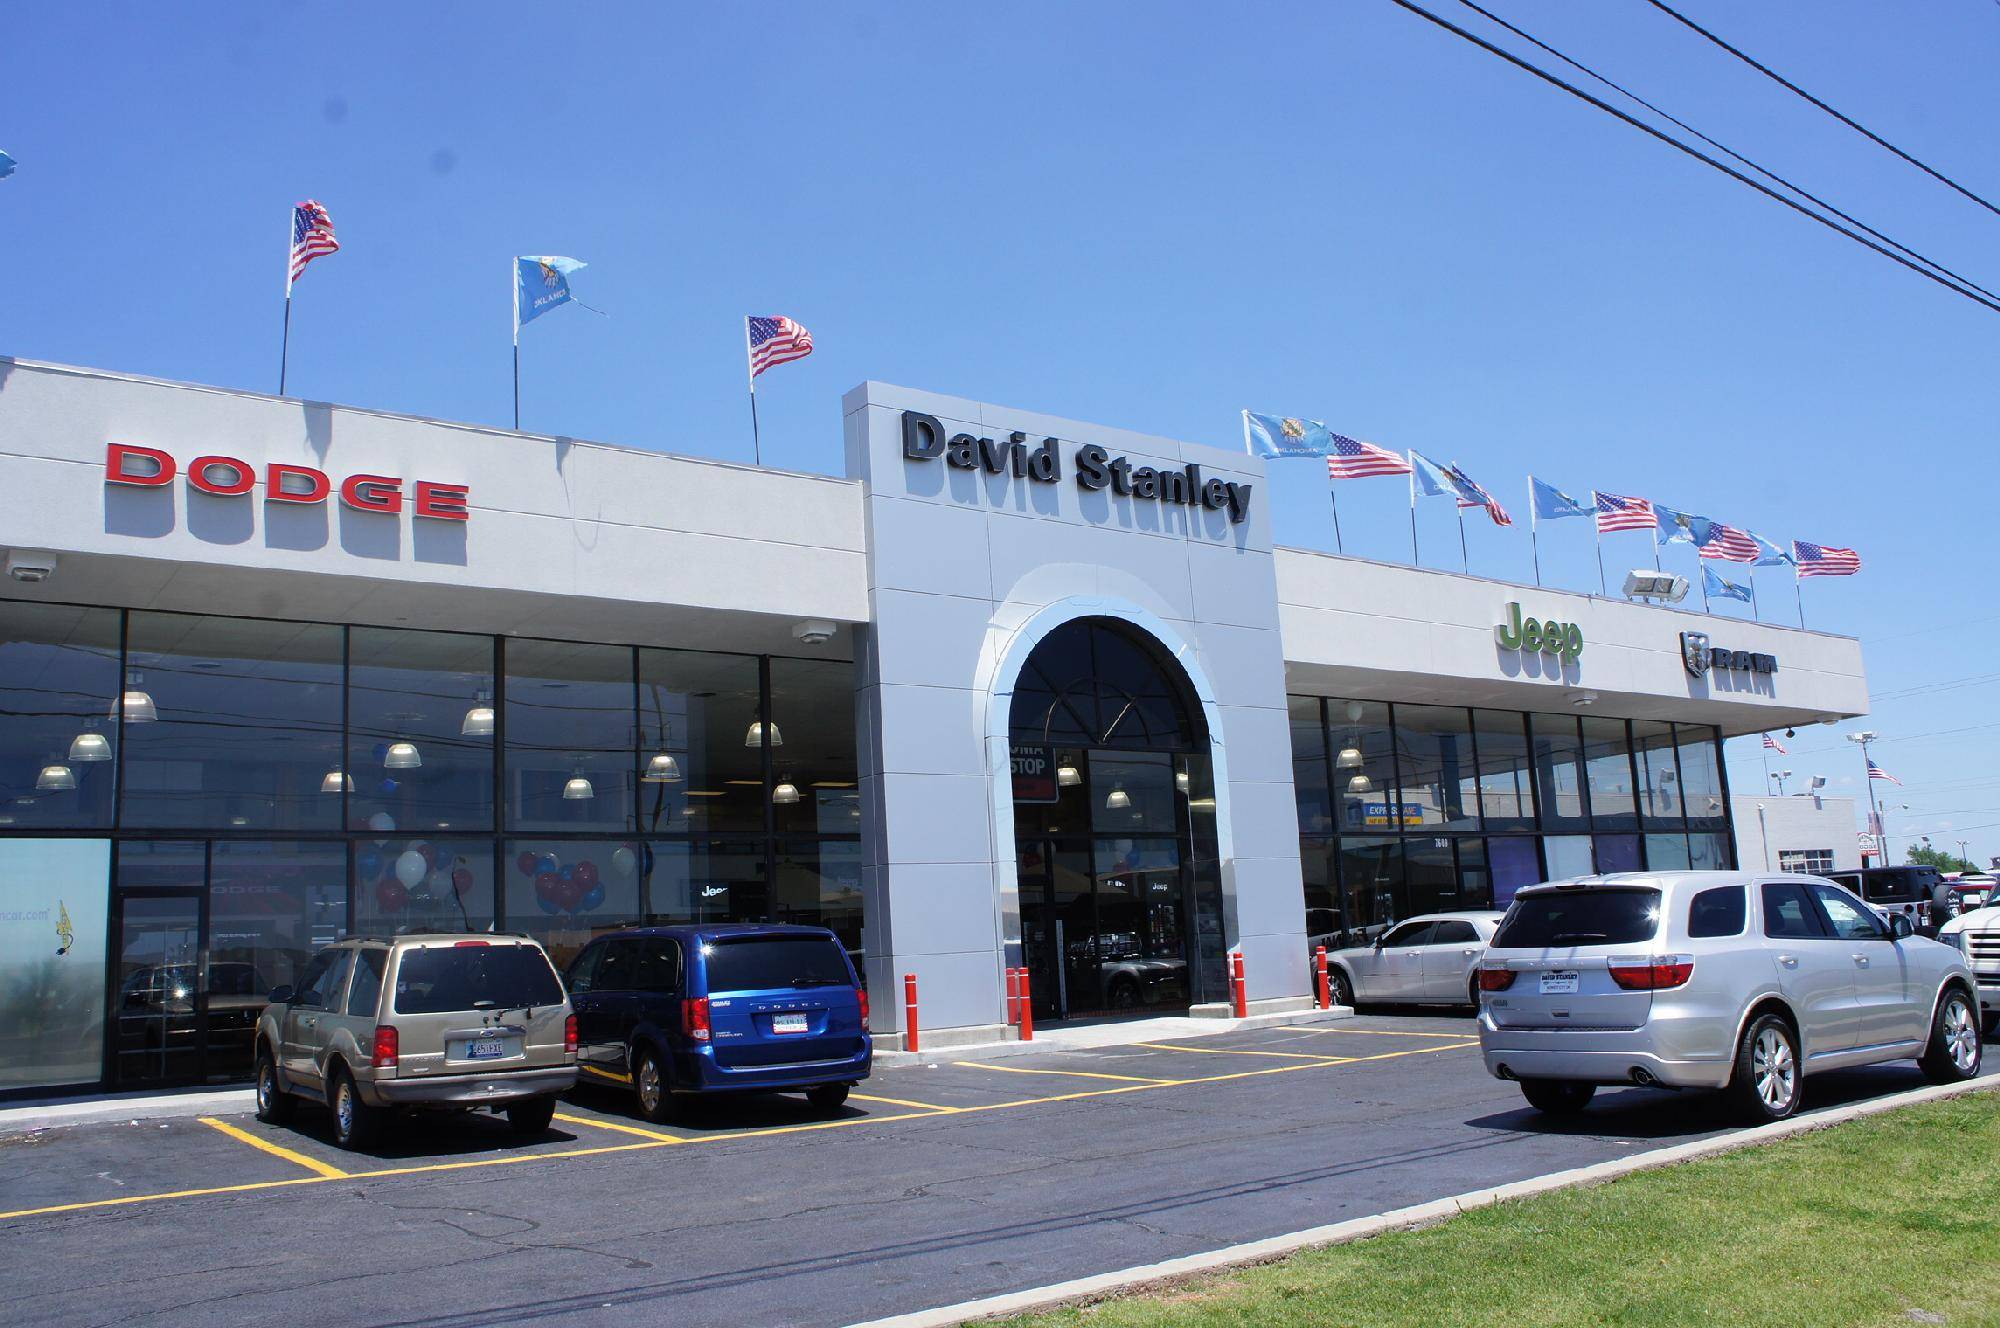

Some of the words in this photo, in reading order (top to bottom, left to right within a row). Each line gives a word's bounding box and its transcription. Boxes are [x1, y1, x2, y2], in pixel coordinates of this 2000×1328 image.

[105, 442, 469, 521] DODGE
[902, 410, 1061, 482] David
[1076, 444, 1252, 522] Stanley
[1493, 601, 1583, 665] Jeep
[1709, 648, 1778, 672] RAM
[1010, 757, 1045, 775] STOP
